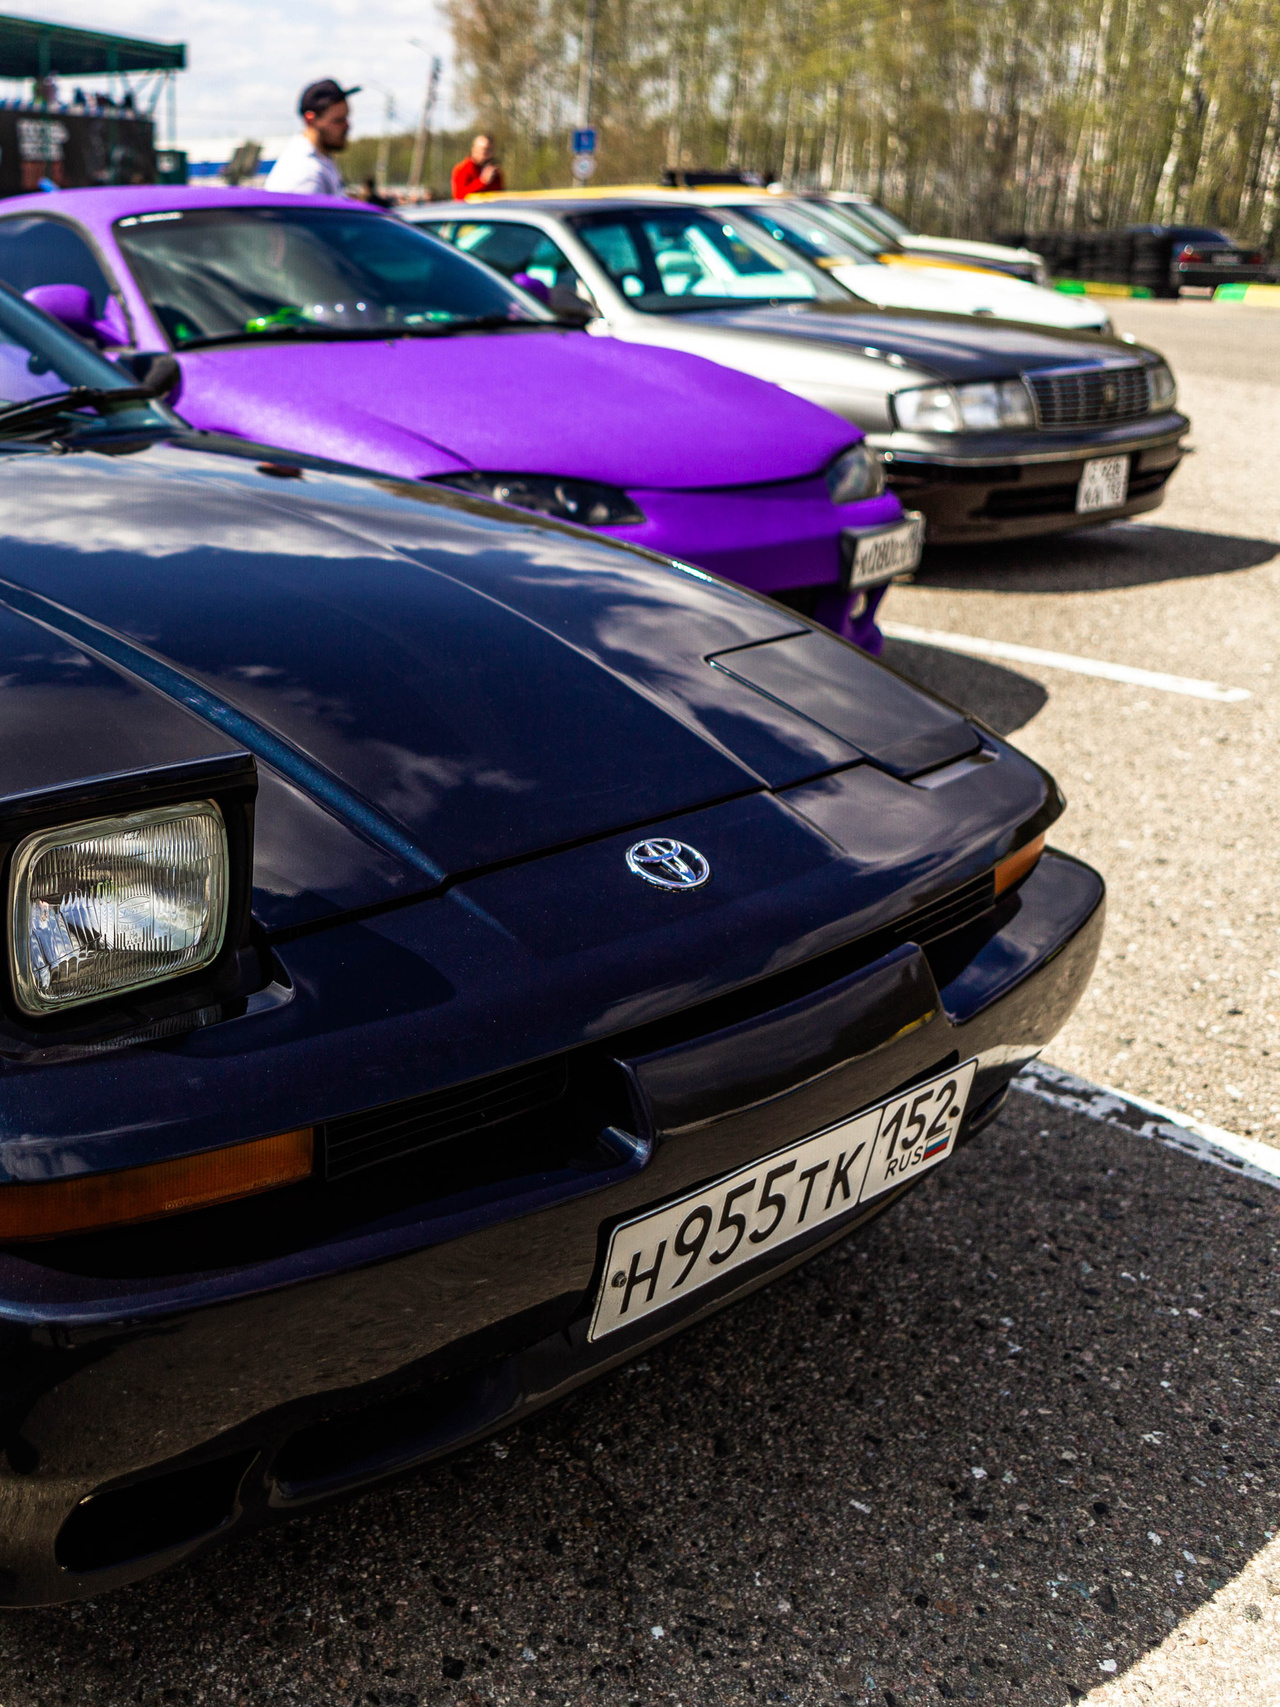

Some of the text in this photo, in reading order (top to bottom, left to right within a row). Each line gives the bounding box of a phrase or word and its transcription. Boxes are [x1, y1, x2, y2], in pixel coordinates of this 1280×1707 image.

[620, 1079, 958, 1315] Н955ТК 152
[883, 1145, 925, 1180] RUS
